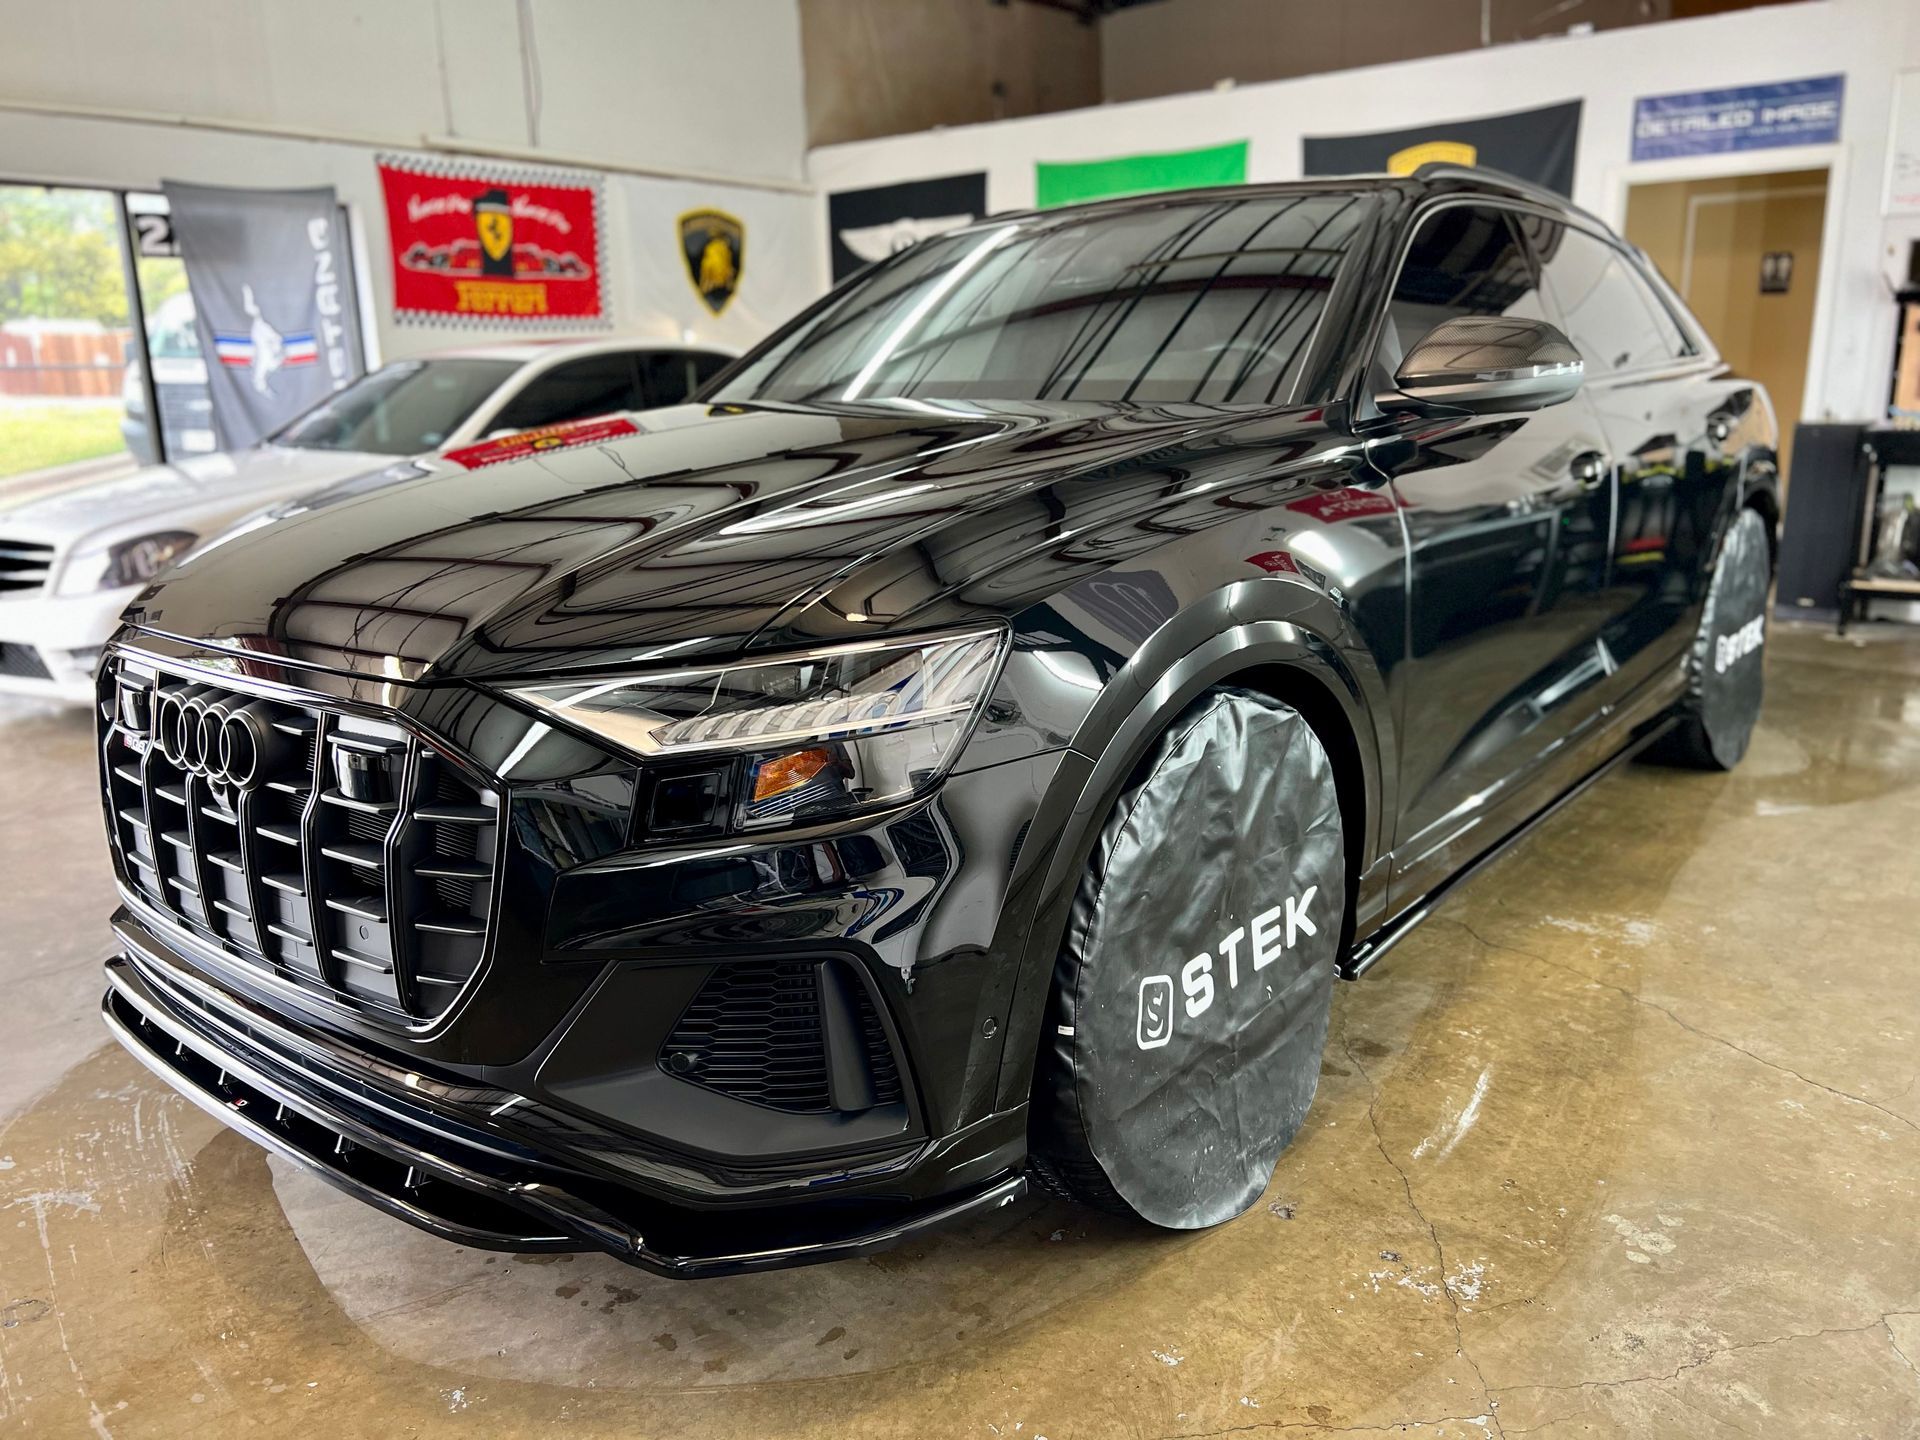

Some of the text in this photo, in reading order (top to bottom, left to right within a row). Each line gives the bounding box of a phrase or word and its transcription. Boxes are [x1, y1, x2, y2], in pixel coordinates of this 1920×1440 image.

[1636, 110, 1755, 139] DETAILED
[1761, 100, 1838, 125] IMAGE
[137, 216, 181, 255] 2
[1181, 885, 1318, 1019] STEK
